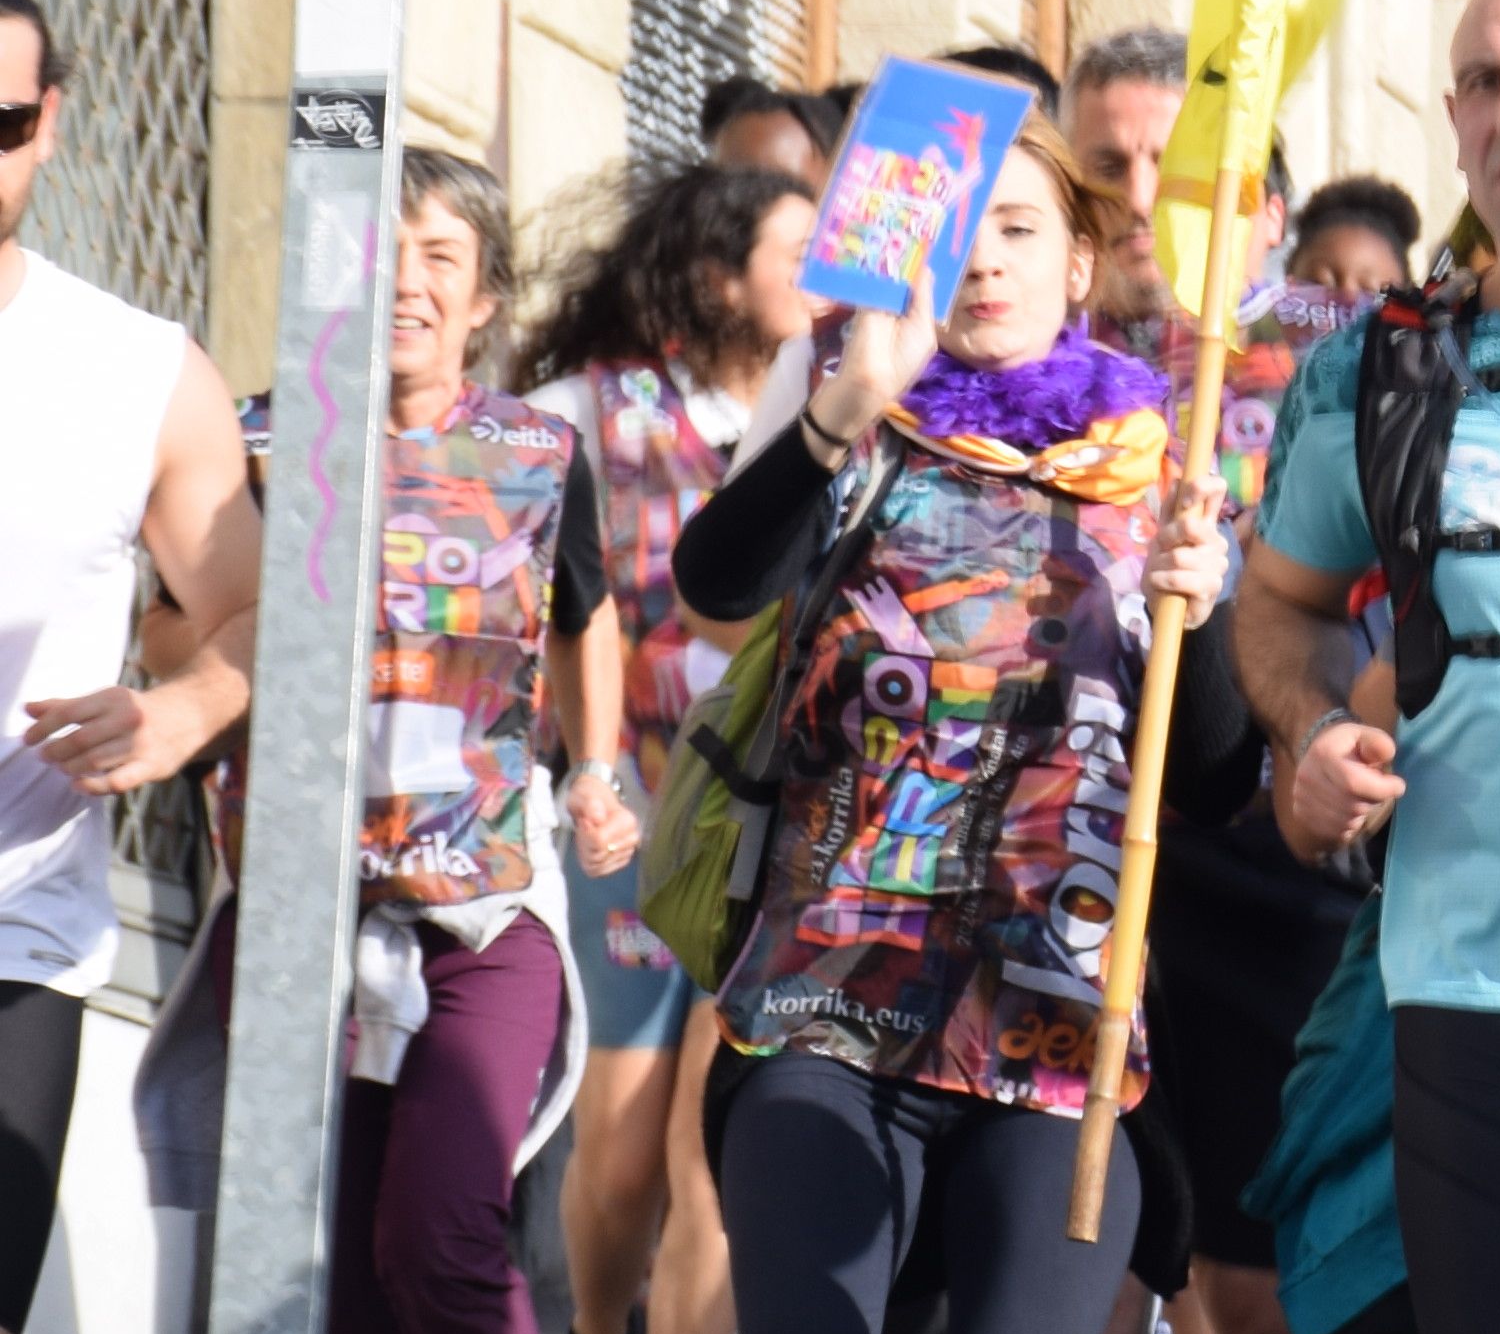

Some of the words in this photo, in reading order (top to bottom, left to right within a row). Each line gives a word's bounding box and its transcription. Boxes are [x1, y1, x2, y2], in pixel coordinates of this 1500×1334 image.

[500, 423, 560, 450] eitb
[761, 988, 928, 1036] korrika.eus
[1000, 1011, 1094, 1070] ae
